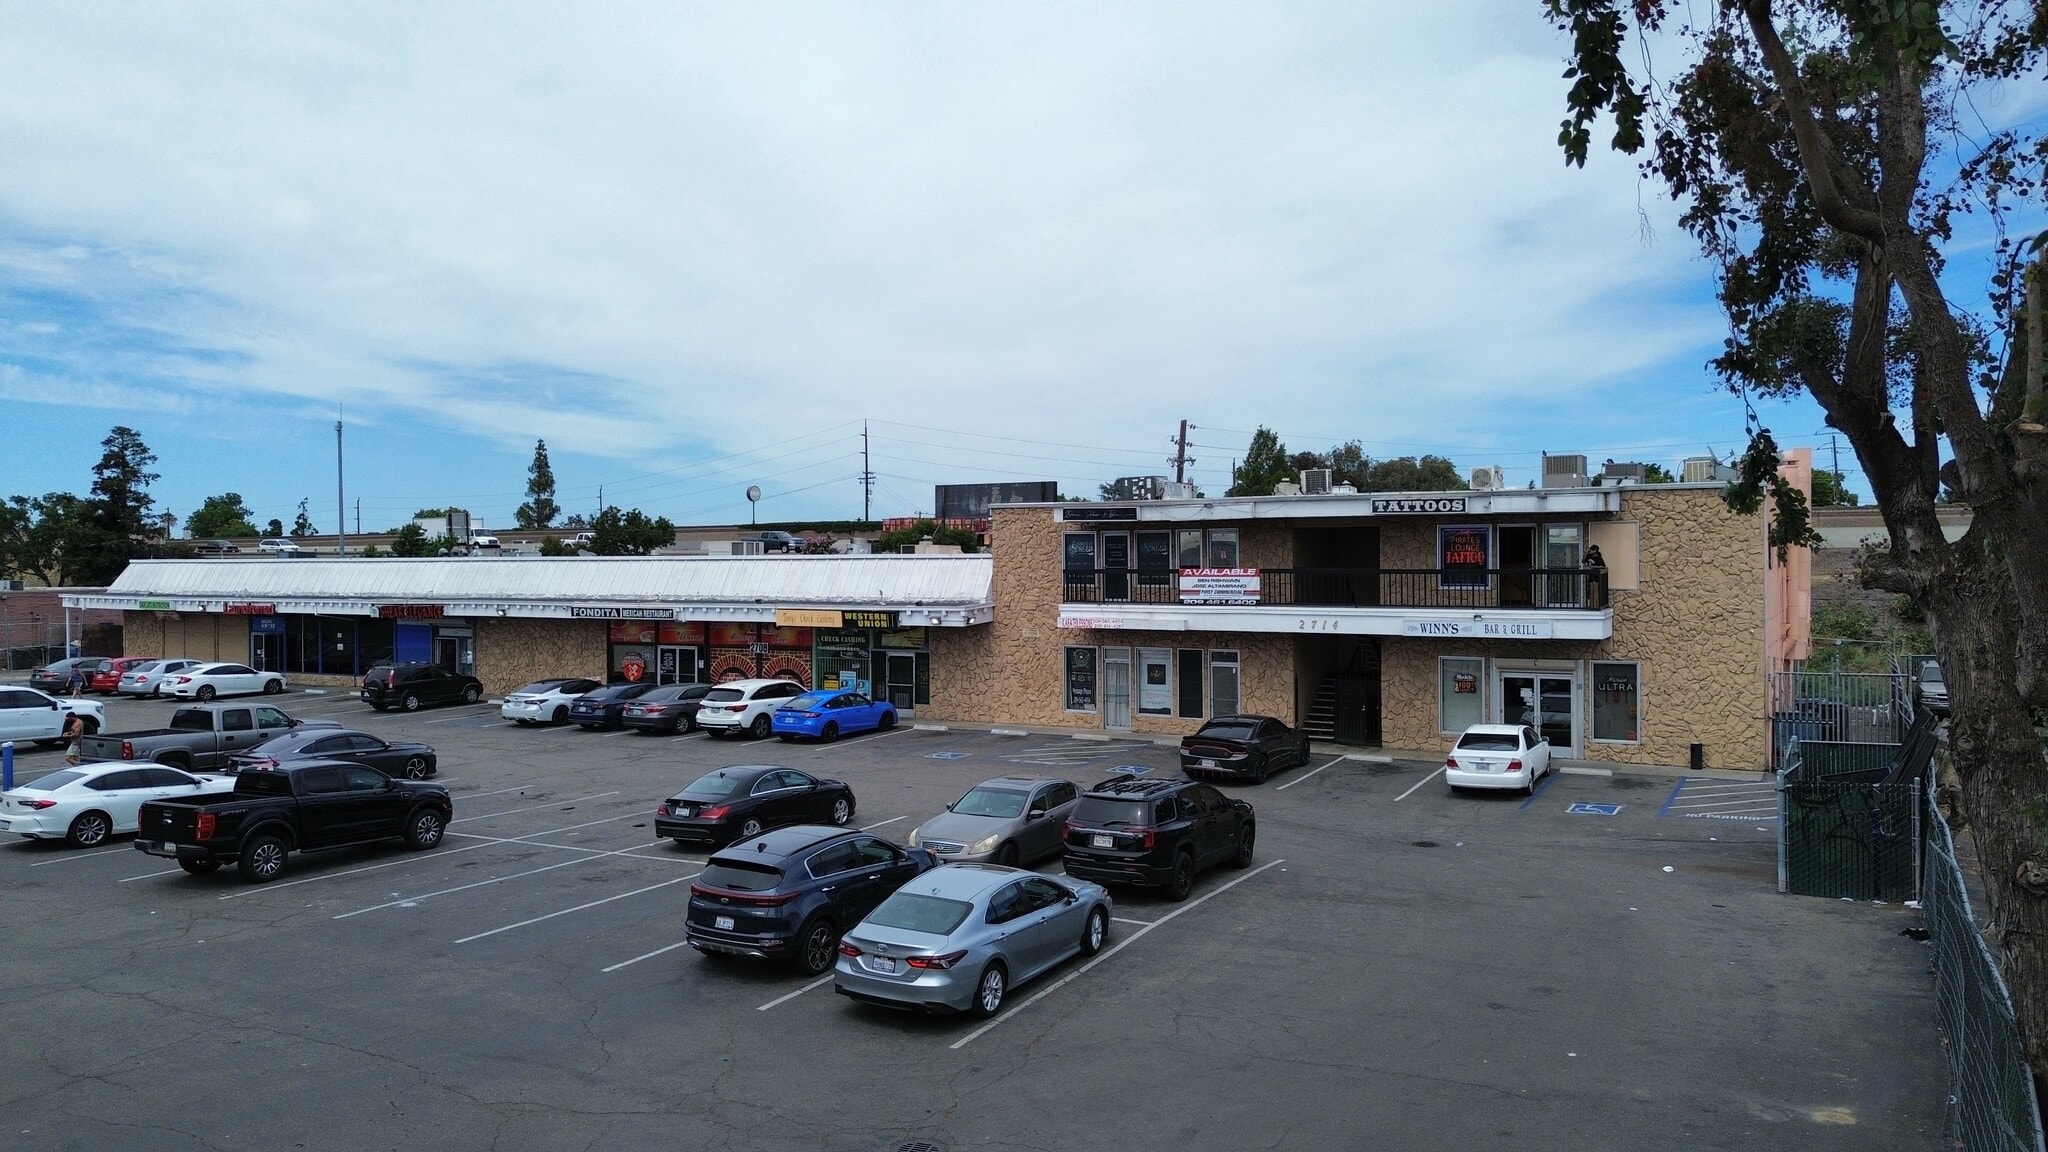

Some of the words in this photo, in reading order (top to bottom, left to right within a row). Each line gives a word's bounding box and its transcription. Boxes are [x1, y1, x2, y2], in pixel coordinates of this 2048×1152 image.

[1375, 500, 1464, 512] TATTOOS
[1446, 551, 1485, 564] TATTOO
[1183, 568, 1257, 576] AVAILABLE
[573, 608, 618, 617] FONDITA
[622, 609, 642, 617] MEXICAN
[643, 609, 673, 618] RESTAURANT
[844, 612, 888, 620] WESTERN
[857, 619, 888, 628] UNION
[1420, 622, 1459, 635] WINN'S
[1484, 624, 1499, 634] BAR
[1510, 625, 1537, 635] GRILL
[821, 635, 840, 643] CHECK
[750, 643, 768, 653] 2708
[1598, 683, 1634, 691] ULTRA
